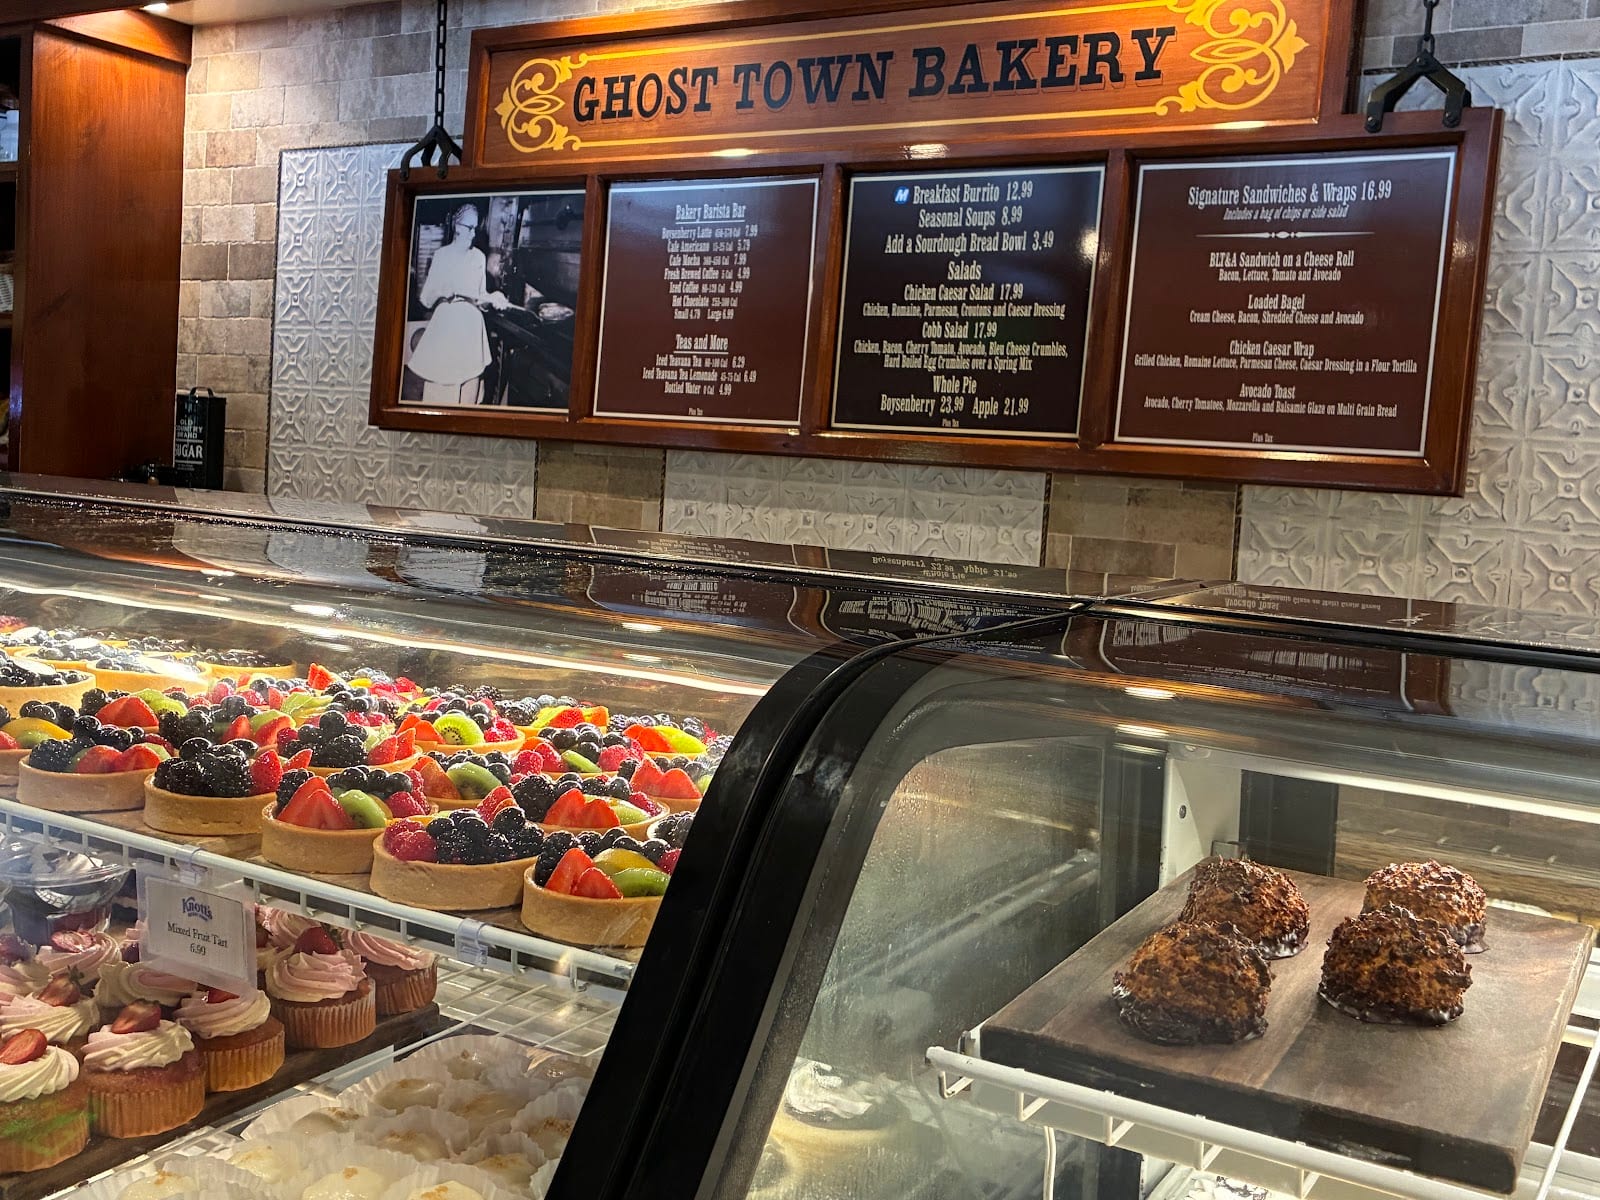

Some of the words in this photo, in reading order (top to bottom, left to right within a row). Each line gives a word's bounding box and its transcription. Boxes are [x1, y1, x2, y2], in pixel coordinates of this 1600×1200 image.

[572, 65, 718, 123] GHOST
[735, 51, 895, 111] TOWN
[908, 26, 1176, 97] BAKERY
[913, 183, 960, 204] Breakfast
[963, 182, 999, 203] Burrito
[1006, 180, 1033, 201] 12.99
[1188, 185, 1239, 210] Signature
[1242, 184, 1307, 205] Sandwiches
[1310, 182, 1318, 202] &
[1322, 182, 1357, 206] Wraps
[1361, 179, 1392, 201] 16.99
[675, 203, 702, 222] Bakery
[703, 203, 730, 219] Barista
[732, 202, 746, 218] Bar
[918, 207, 962, 228] Seasonal
[965, 208, 995, 230] Soups
[1001, 205, 1022, 226] 8.99
[1283, 206, 1301, 222] chips
[1311, 205, 1326, 218] side
[1327, 204, 1349, 218] salad
[885, 232, 904, 253] Add
[906, 238, 912, 253] a
[915, 232, 967, 257] Sourdough
[970, 231, 999, 252] Bread
[1002, 230, 1026, 251] Bowl
[1032, 230, 1054, 251] 3.49
[1209, 252, 1237, 267] BLT&A
[1239, 251, 1280, 267] Sandwich
[1282, 256, 1293, 267] on
[1303, 251, 1333, 267] Cheese
[1336, 250, 1354, 266] Roll
[947, 260, 982, 280] Salads
[1218, 268, 1241, 282] Bacon,
[1243, 269, 1269, 282] Lettuce,
[1272, 268, 1296, 281] Tomato
[1298, 268, 1312, 281] and
[1313, 267, 1341, 281] Avocado
[904, 283, 936, 301] Chicken
[938, 283, 968, 301] Caesar
[969, 283, 994, 301] Salad
[999, 283, 1024, 300] 17.99
[863, 302, 890, 318] Chicken,
[923, 303, 959, 318] Parmesan,
[961, 303, 991, 317] Croutons
[993, 303, 1006, 317] and
[1007, 303, 1032, 317] Caesar
[1033, 302, 1065, 320] Dressing
[1247, 294, 1279, 309] Loaded
[1280, 294, 1305, 313] Bagel
[1189, 310, 1210, 323] Cream
[1211, 310, 1236, 324] Cheese,
[1237, 310, 1260, 324] Bacon,
[1262, 311, 1294, 324] Shredded
[1295, 311, 1318, 324] Cheese
[1320, 311, 1334, 324] and
[1335, 311, 1364, 325] Avocado
[922, 321, 942, 339] Cobb
[944, 321, 968, 339] Salad
[974, 321, 997, 339] 17.99
[675, 333, 692, 350] Teas
[694, 333, 708, 350] and
[709, 334, 728, 351] More
[853, 339, 881, 355] Chicken,
[882, 340, 904, 355] Bacon,
[905, 340, 930, 357] Cherry
[930, 341, 956, 356] Tomato,
[957, 341, 987, 357] Avocado,
[988, 342, 1004, 356] Bleu
[1006, 342, 1030, 356] Cheese
[1031, 342, 1068, 358] Crumbles,
[1229, 340, 1261, 356] Chicken
[1263, 341, 1291, 356] Caesar
[1293, 341, 1315, 359] Wrap
[883, 354, 900, 368] Hard
[901, 355, 922, 368] Boiled
[924, 355, 937, 372] Egg
[938, 356, 970, 370] Crumbles
[971, 359, 986, 370] over
[994, 356, 1018, 373] Spring
[1019, 357, 1032, 370] Mix
[1134, 354, 1155, 367] Grilled
[1156, 354, 1182, 368] Chicken,
[1184, 355, 1211, 368] Romaine
[1212, 356, 1238, 370] Lettuce,
[1239, 357, 1272, 370] Parmesan
[1274, 357, 1298, 371] Cheese,
[1300, 358, 1323, 371] Caesar
[1324, 358, 1355, 375] Dressing
[1356, 359, 1363, 371] in
[1371, 359, 1391, 372] Flour
[1392, 359, 1417, 373] Tortilla
[933, 375, 960, 393] Whole
[962, 375, 977, 394] Pie
[1239, 383, 1272, 398] Avocado
[1274, 384, 1295, 399] Toast
[880, 393, 936, 417] Boysenberry
[940, 396, 964, 414] 23.99
[972, 397, 998, 419] Apple
[1003, 397, 1029, 416] 21.99
[1144, 396, 1170, 410] Avocado,
[1171, 396, 1194, 412] Cherry
[1194, 397, 1225, 411] Tomatoes,
[1226, 399, 1260, 412] Mozzarella
[1262, 400, 1274, 413] and
[1275, 401, 1306, 414] Balsamic
[1307, 401, 1325, 415] Glaze
[1327, 405, 1335, 415] on
[1336, 402, 1355, 416] Multi
[1356, 403, 1375, 417] Grain
[1377, 404, 1397, 418] Bread
[182, 896, 213, 920] Knott's
[167, 921, 191, 937] Mixed
[192, 928, 211, 943] Fruit
[212, 934, 228, 948] Tart
